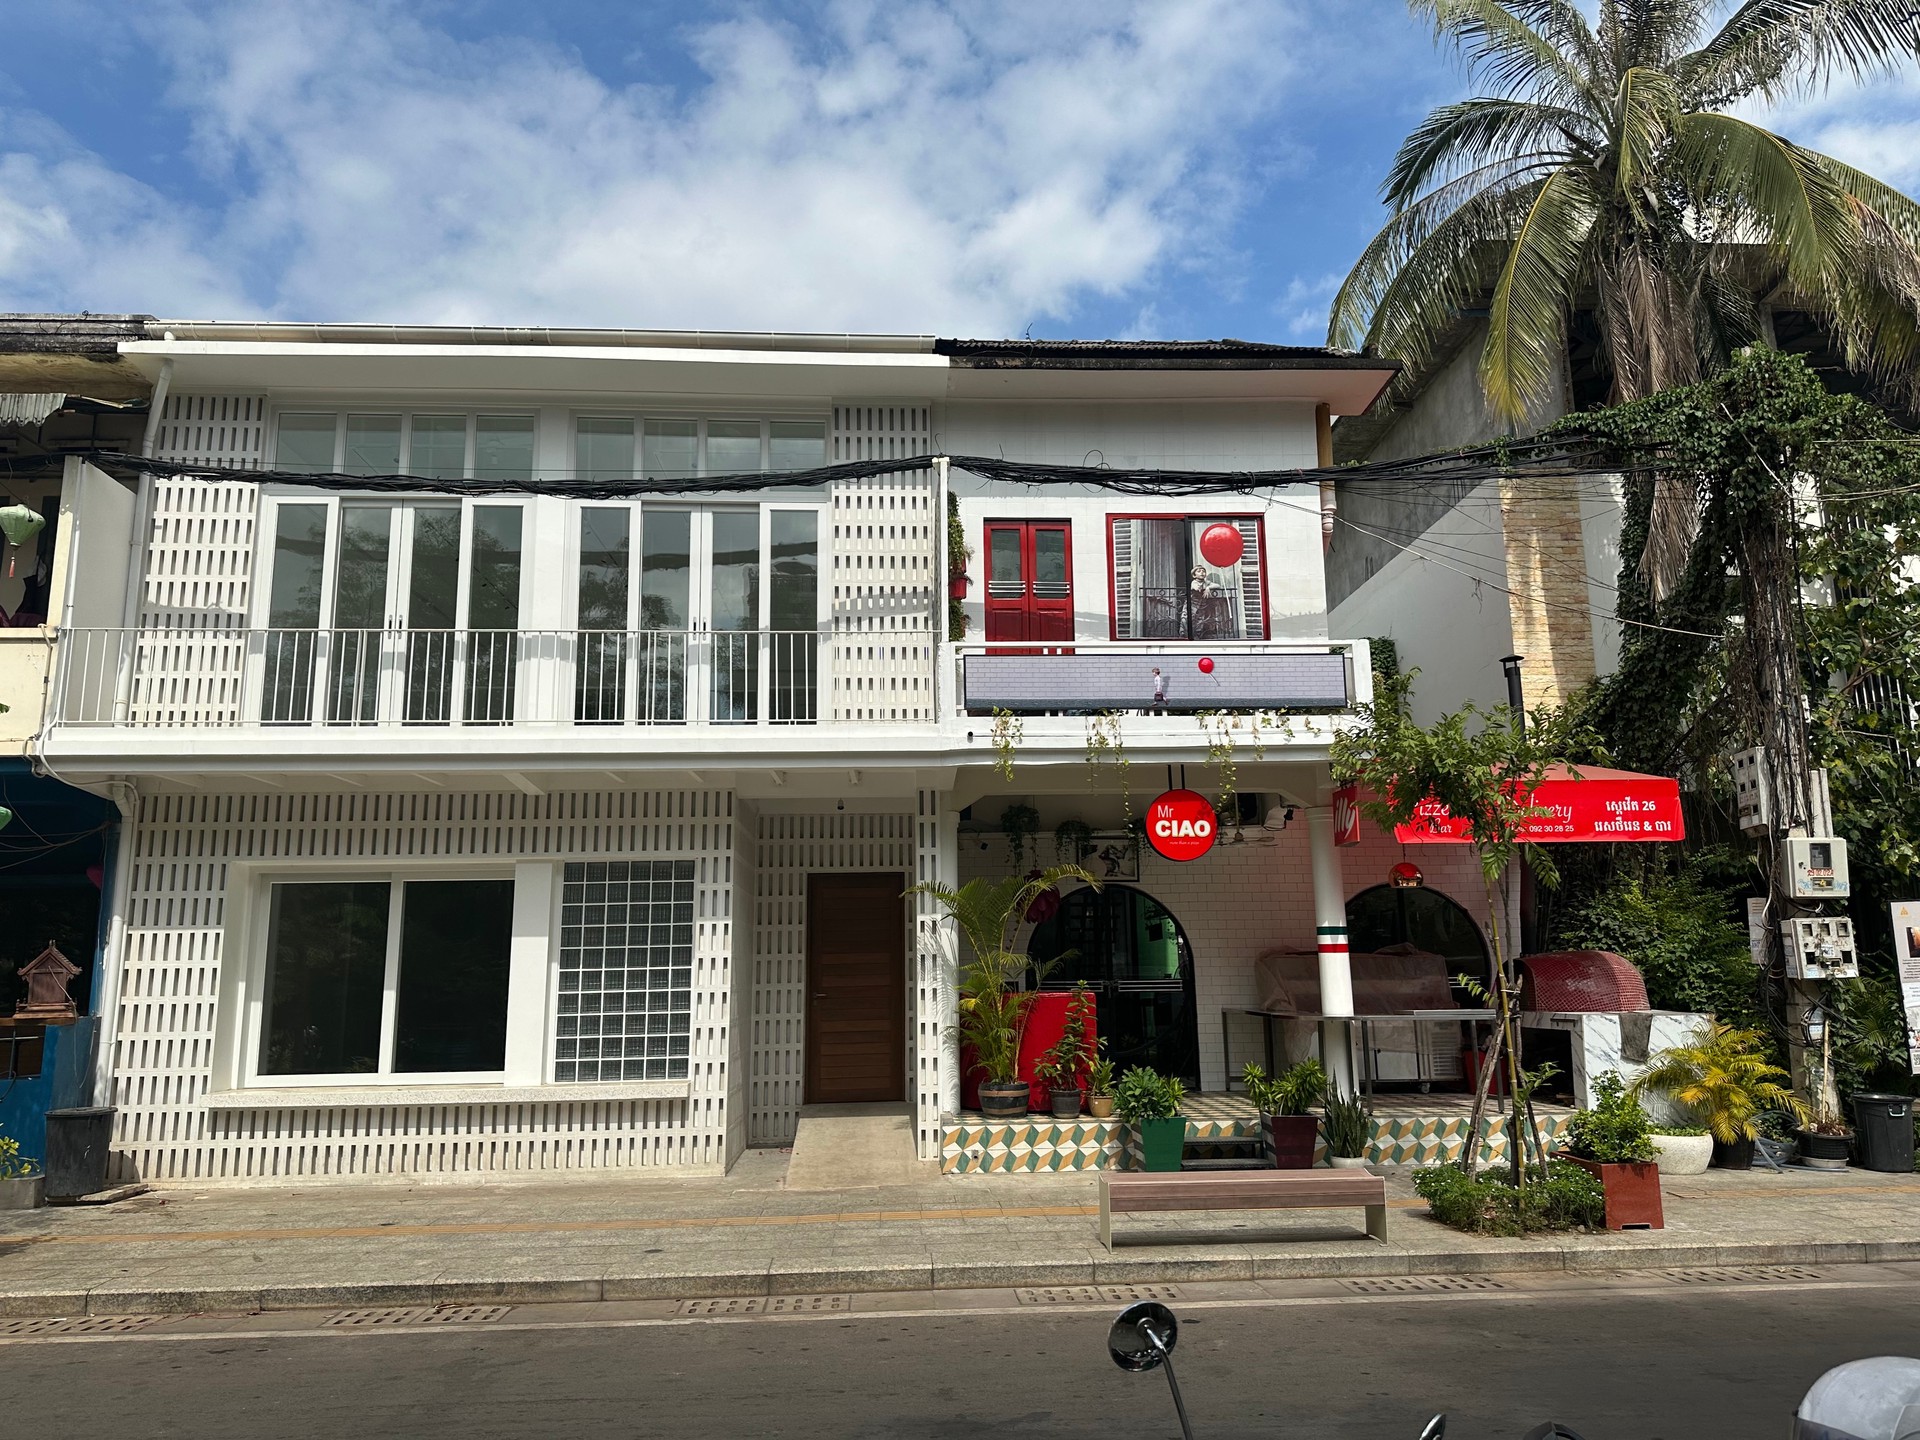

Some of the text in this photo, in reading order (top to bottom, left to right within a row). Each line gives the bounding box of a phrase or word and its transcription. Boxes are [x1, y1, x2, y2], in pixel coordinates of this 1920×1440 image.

[1157, 805, 1174, 818] Mr
[1642, 801, 1656, 811] 26
[1334, 797, 1356, 840] illy
[1155, 820, 1211, 838] CIAO
[1643, 821, 1653, 831] &
[1655, 821, 1672, 831] បារ
